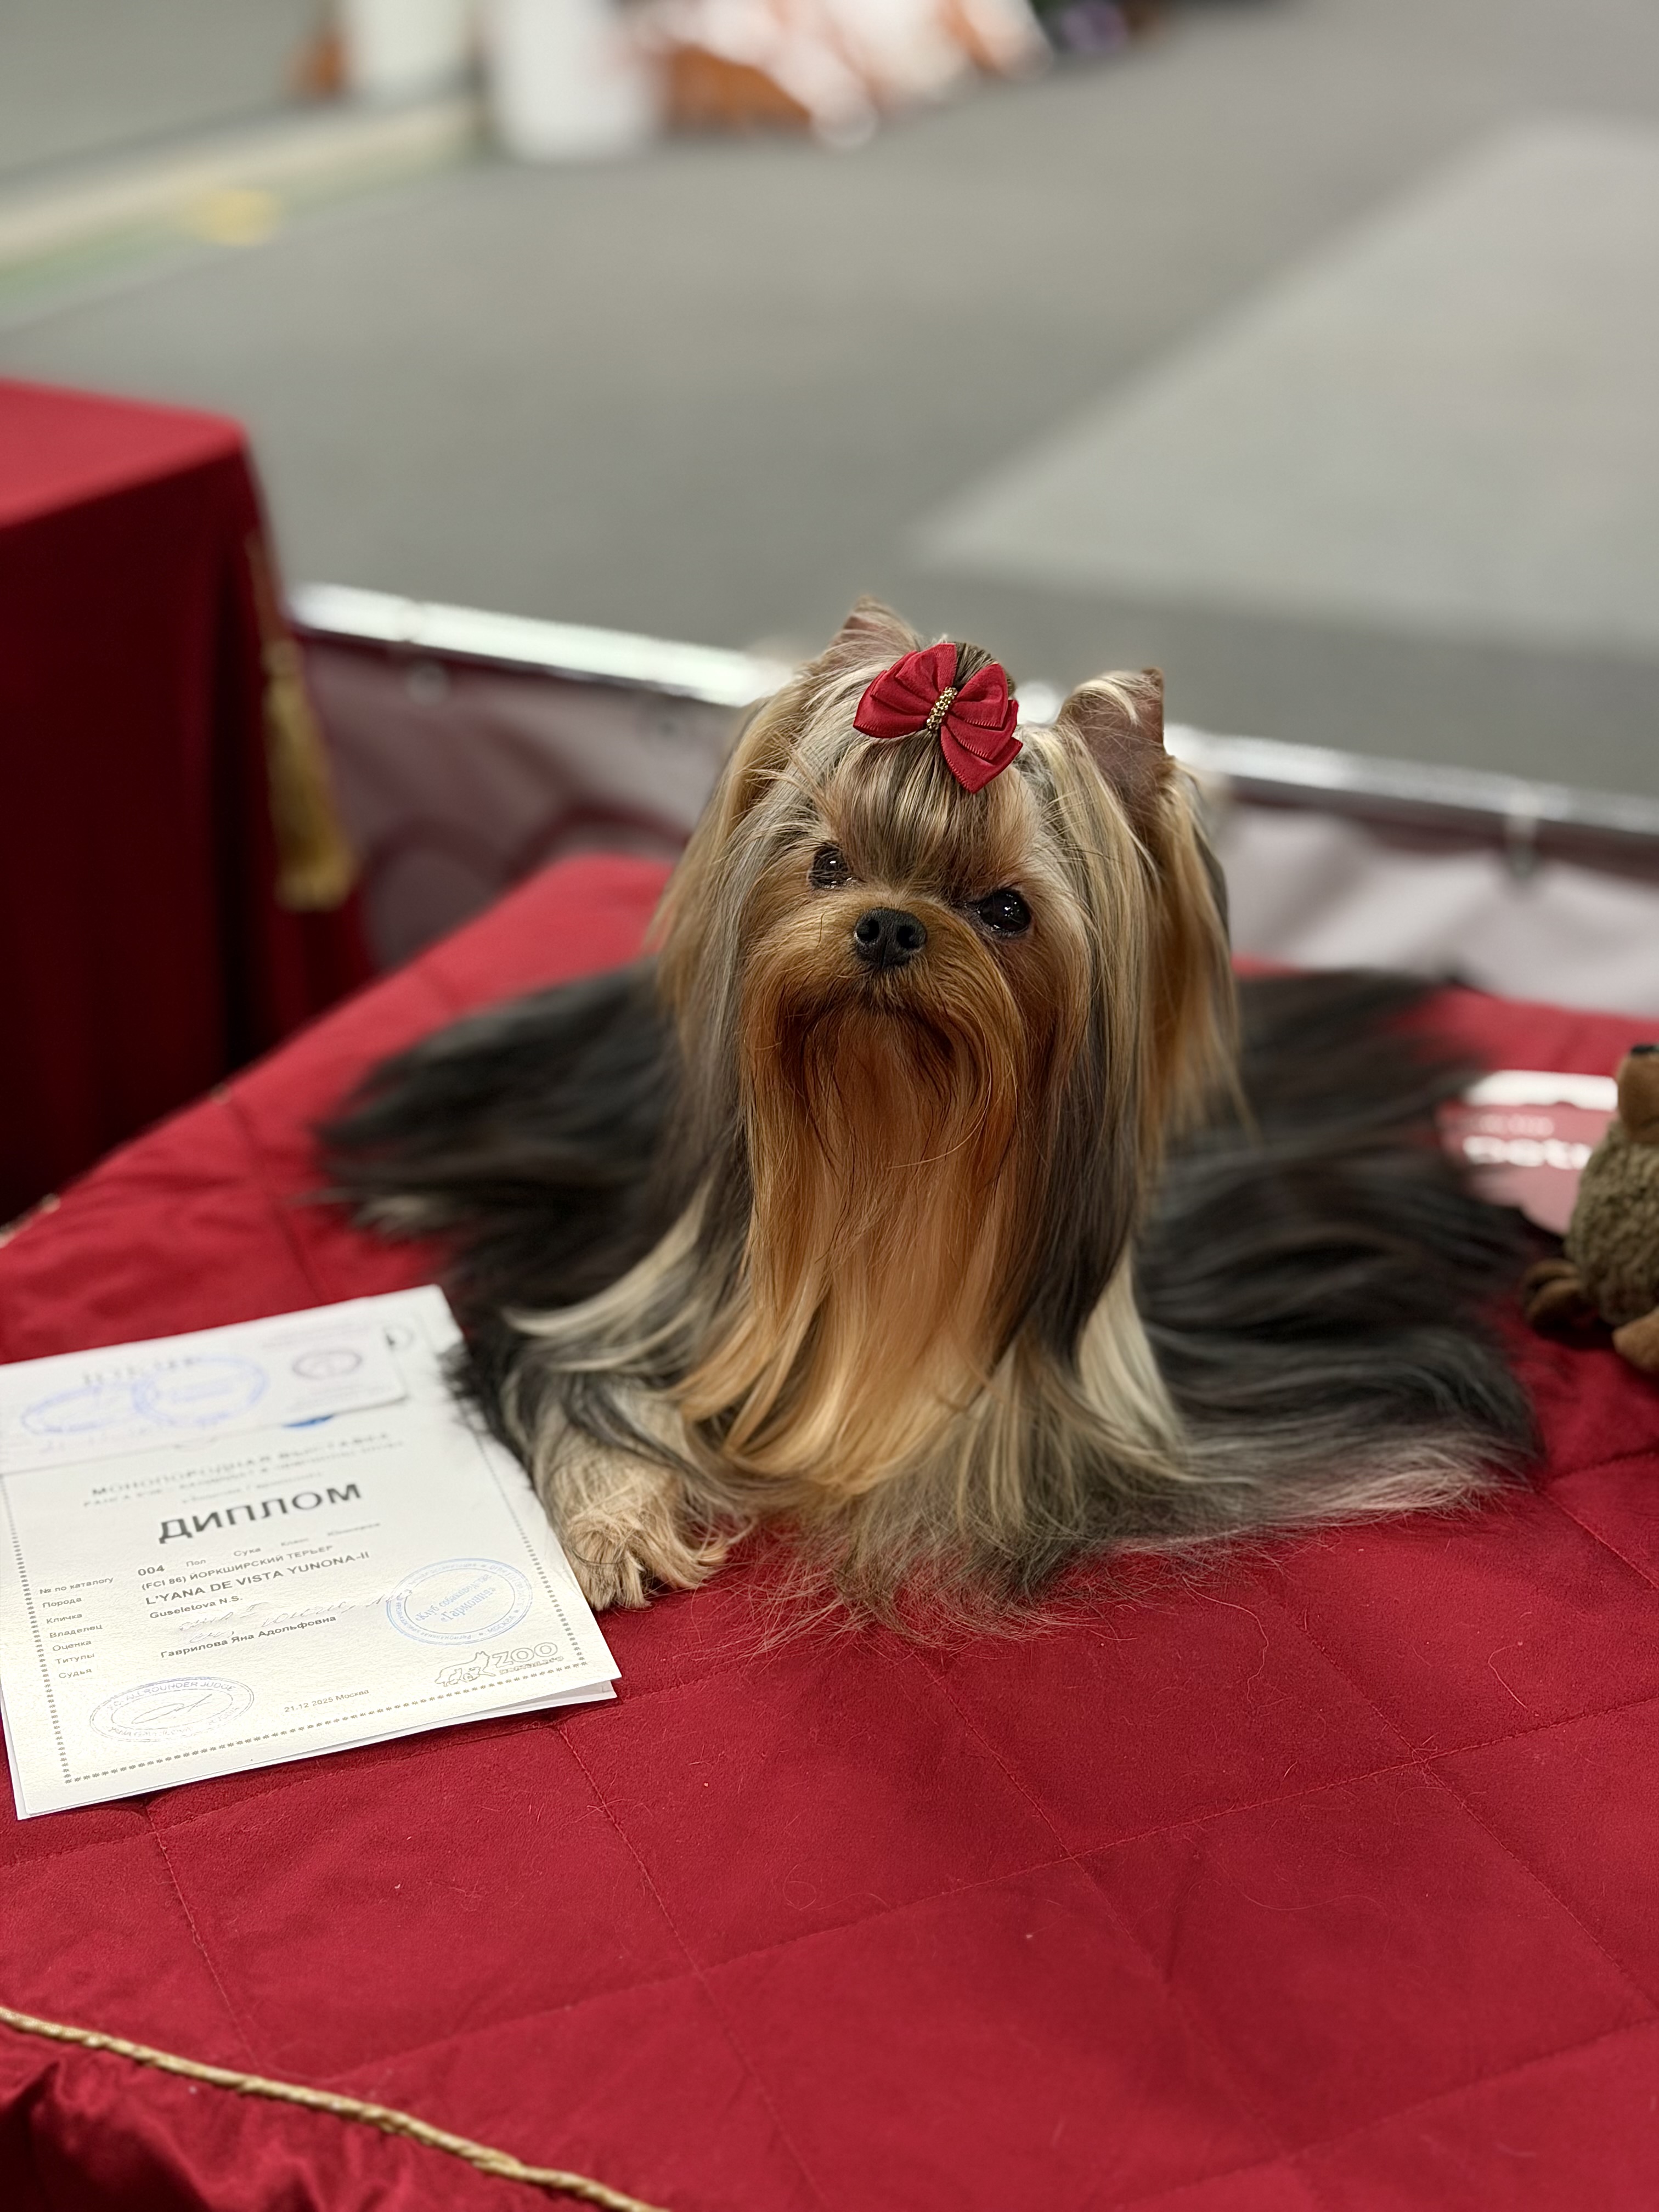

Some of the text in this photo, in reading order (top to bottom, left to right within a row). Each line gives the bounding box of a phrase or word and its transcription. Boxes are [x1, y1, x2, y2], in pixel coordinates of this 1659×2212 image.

[159, 1483, 362, 1544] ДИПЛОМ
[233, 1547, 261, 1557] Сука
[142, 1545, 334, 1591] (FCI 86) ЙОРКШИРСКИЙ ТЕРЬЕР
[186, 1559, 206, 1567] Пол
[138, 1565, 166, 1576] 004
[70, 1577, 114, 1590] каталогу
[145, 1551, 370, 1605] L'YANA DE VISTA YUNONA-II
[42, 1597, 82, 1609] Порода
[149, 1601, 217, 1620] Guseletova
[218, 1595, 243, 1605] N.S.
[46, 1613, 83, 1624] Кличка
[49, 1624, 103, 1639] Владелец
[160, 1639, 228, 1658] Гаврилова
[231, 1634, 255, 1644] Яна
[258, 1616, 336, 1638] Адольфовна
[53, 1640, 92, 1652] Оценка
[55, 1653, 95, 1665] Титулы
[492, 1642, 558, 1668] ZOO
[59, 1668, 92, 1679] Судья
[200, 1680, 238, 1692] JUDGE
[284, 1689, 370, 1713] 21.12 2025 Москва
